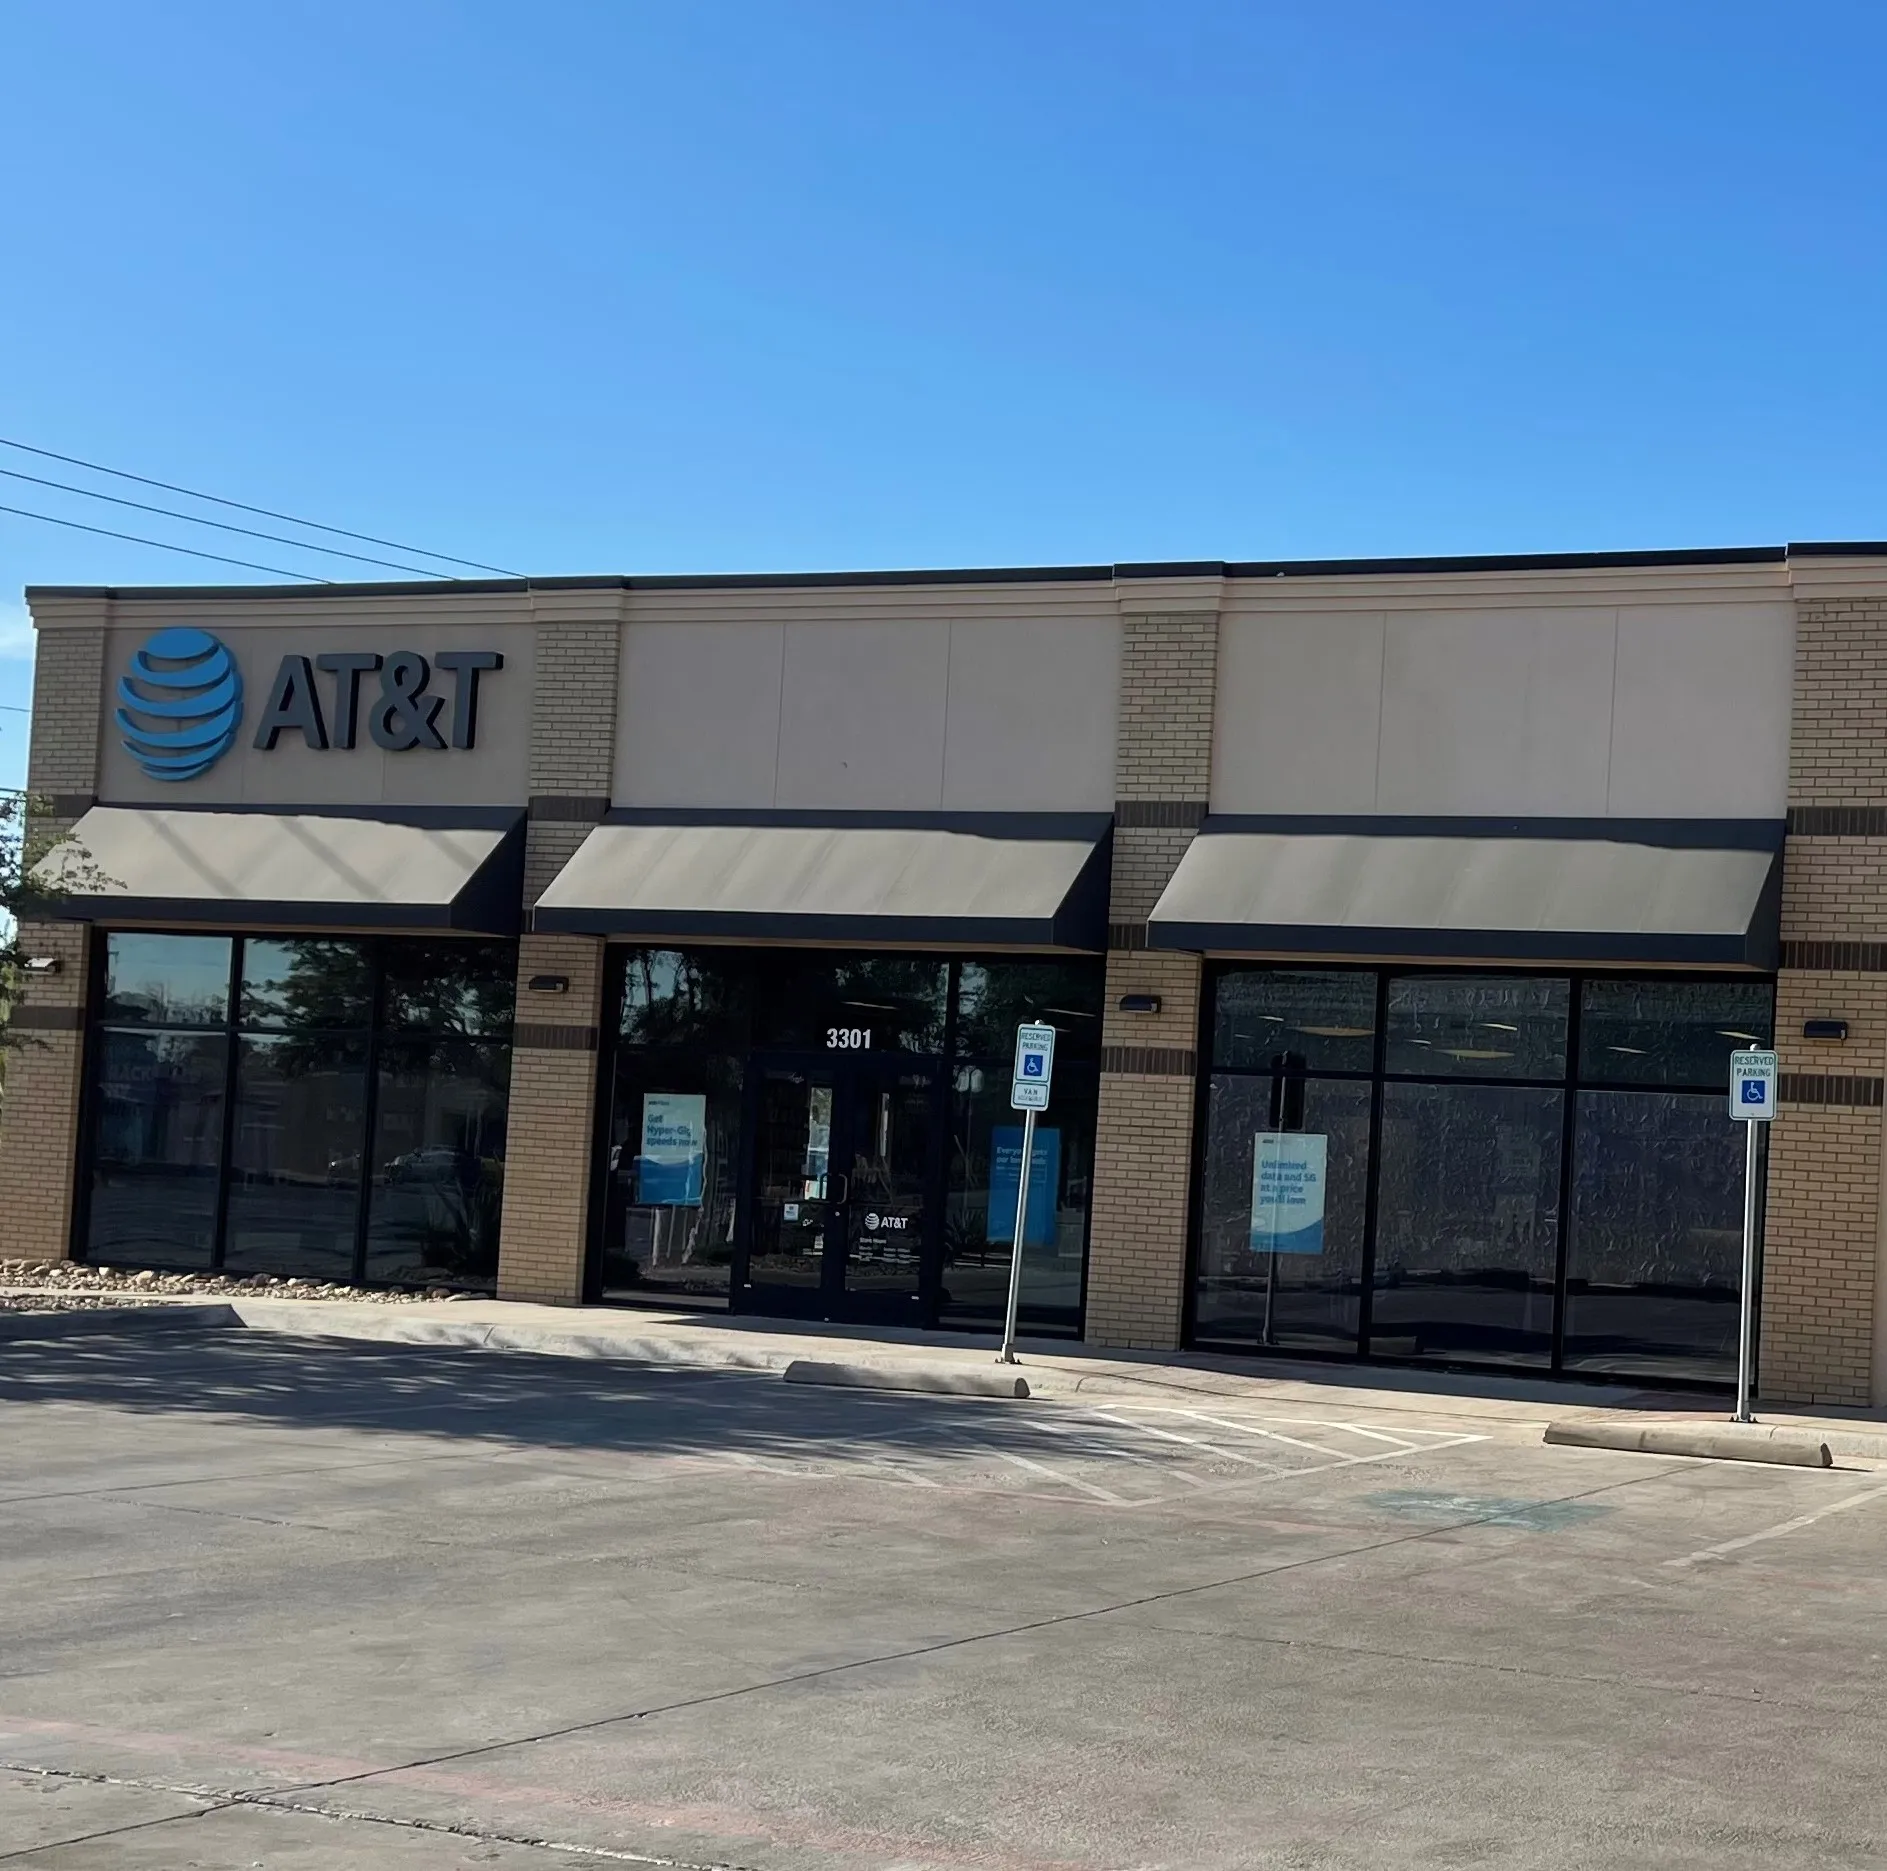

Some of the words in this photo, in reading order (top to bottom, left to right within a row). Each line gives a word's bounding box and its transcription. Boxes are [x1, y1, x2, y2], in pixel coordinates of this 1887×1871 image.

[253, 651, 504, 750] AT&T
[826, 1028, 871, 1049] 3301
[1020, 1032, 1051, 1042] RESERVED
[1022, 1043, 1049, 1051] PARKING
[1734, 1056, 1774, 1066] RESERVED
[1736, 1067, 1771, 1077] PARKING
[1023, 1088, 1038, 1096] VAN
[880, 1216, 909, 1229] AT&T
